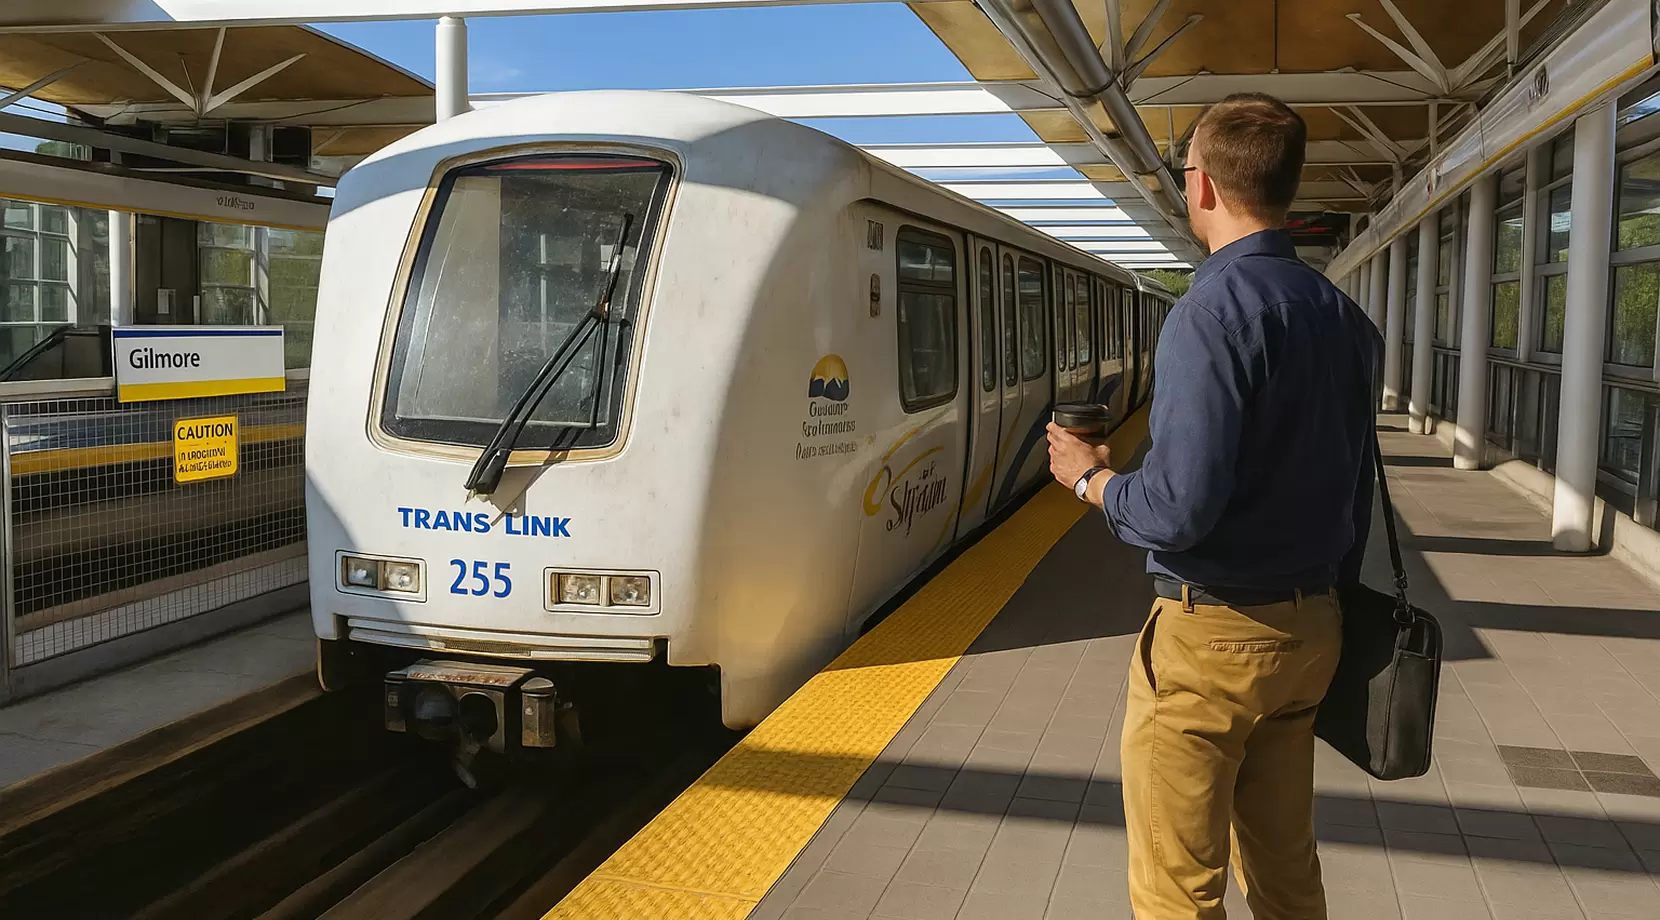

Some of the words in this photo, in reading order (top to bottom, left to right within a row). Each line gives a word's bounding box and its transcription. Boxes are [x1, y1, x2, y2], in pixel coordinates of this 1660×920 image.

[129, 347, 200, 369] Gilmore
[177, 423, 233, 441] CAUTION
[398, 507, 491, 533] TRANS
[505, 513, 572, 537] LINK
[450, 559, 512, 598] 255
